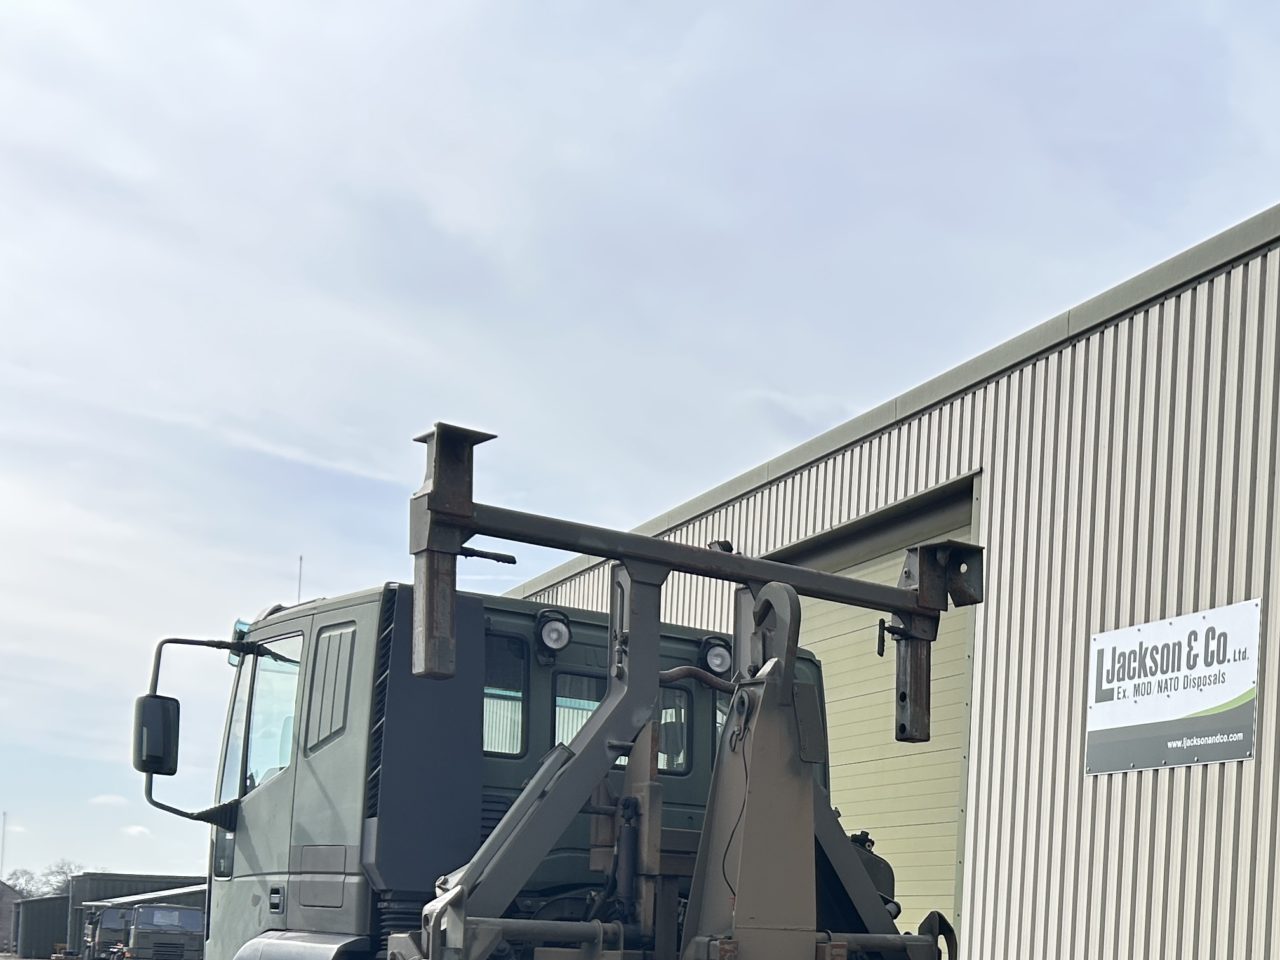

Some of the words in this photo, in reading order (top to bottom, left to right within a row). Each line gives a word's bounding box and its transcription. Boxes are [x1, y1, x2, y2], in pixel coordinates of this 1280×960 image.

[1186, 630, 1199, 670] &
[1233, 647, 1249, 662] Ltd.
[1117, 686, 1129, 700] Ex.
[1133, 677, 1179, 697] MOD/NATO
[1183, 669, 1226, 689] Disposals
[1167, 732, 1243, 749] www.ljacksonandco.com
